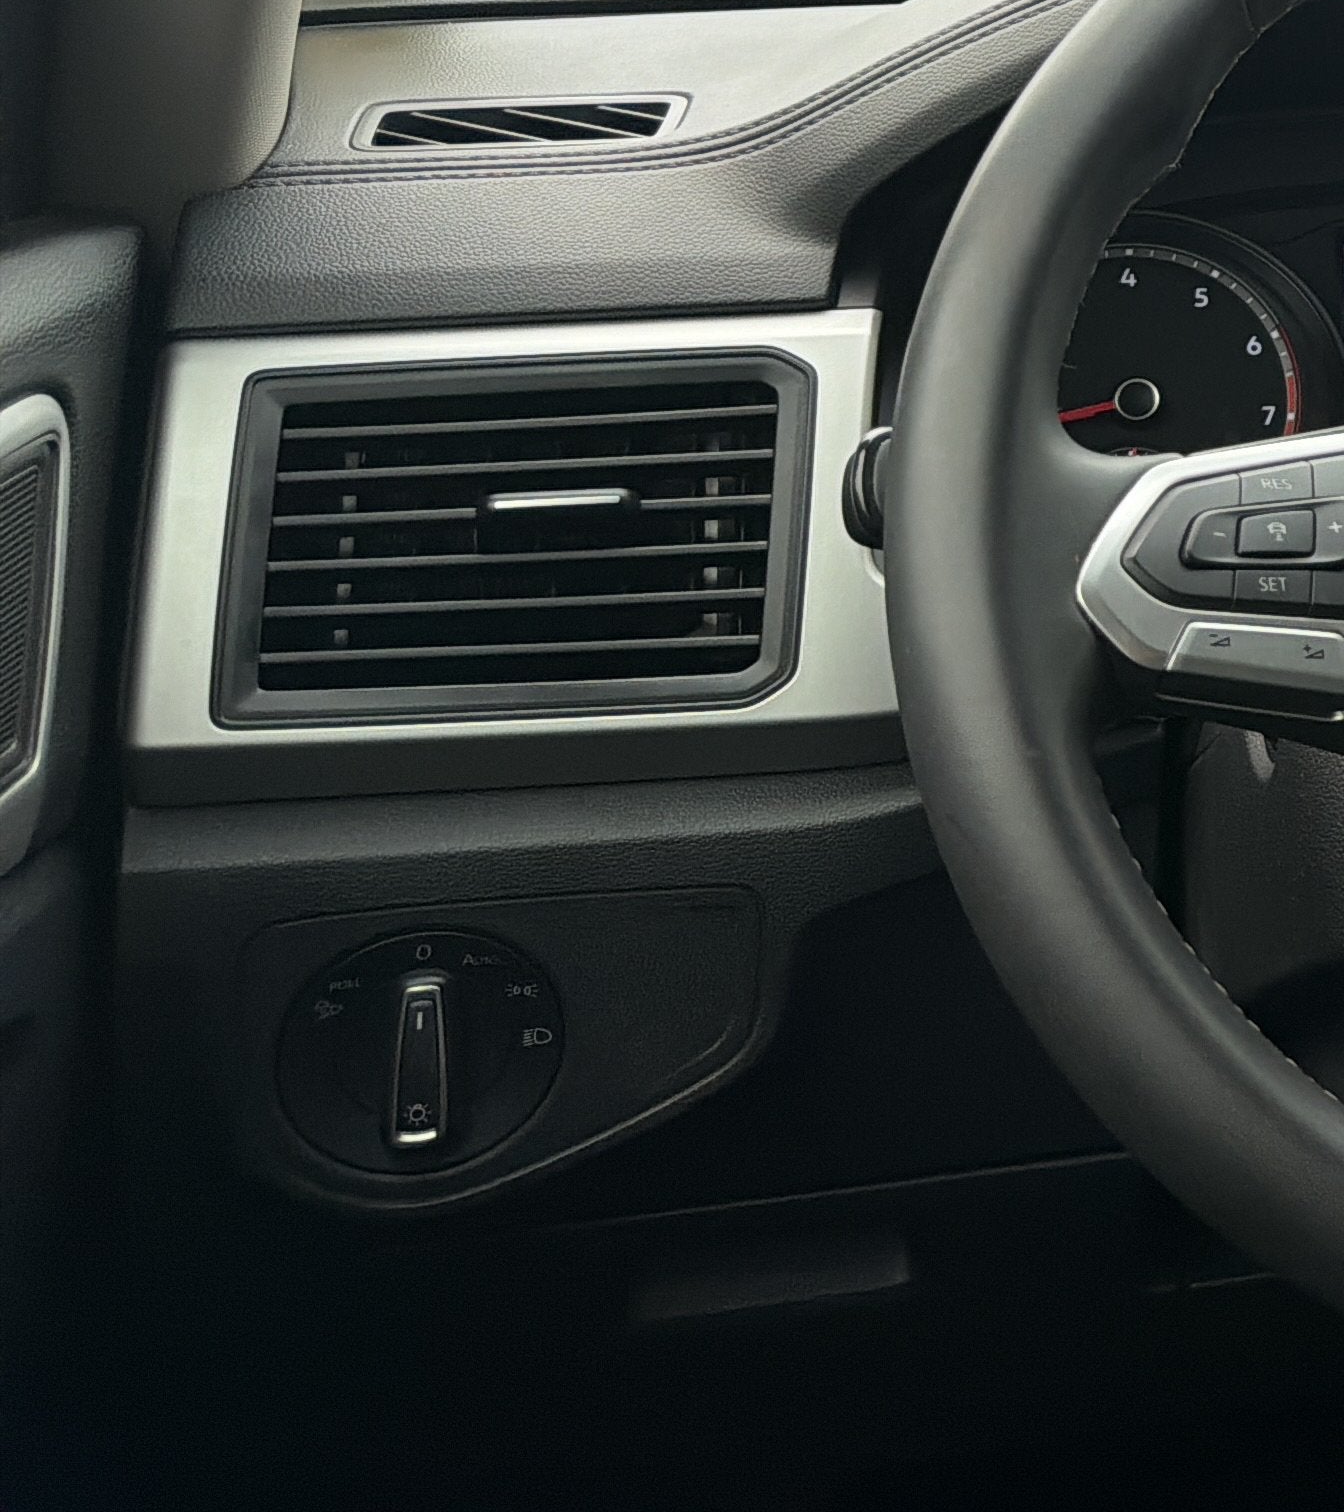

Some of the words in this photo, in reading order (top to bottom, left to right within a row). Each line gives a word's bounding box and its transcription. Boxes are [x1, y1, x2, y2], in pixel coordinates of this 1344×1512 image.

[1120, 268, 1137, 287] 4
[1194, 288, 1208, 308] 5
[1246, 337, 1262, 355] 6
[1261, 406, 1276, 426] 7
[1261, 478, 1292, 490] RES
[1259, 577, 1287, 592] SET
